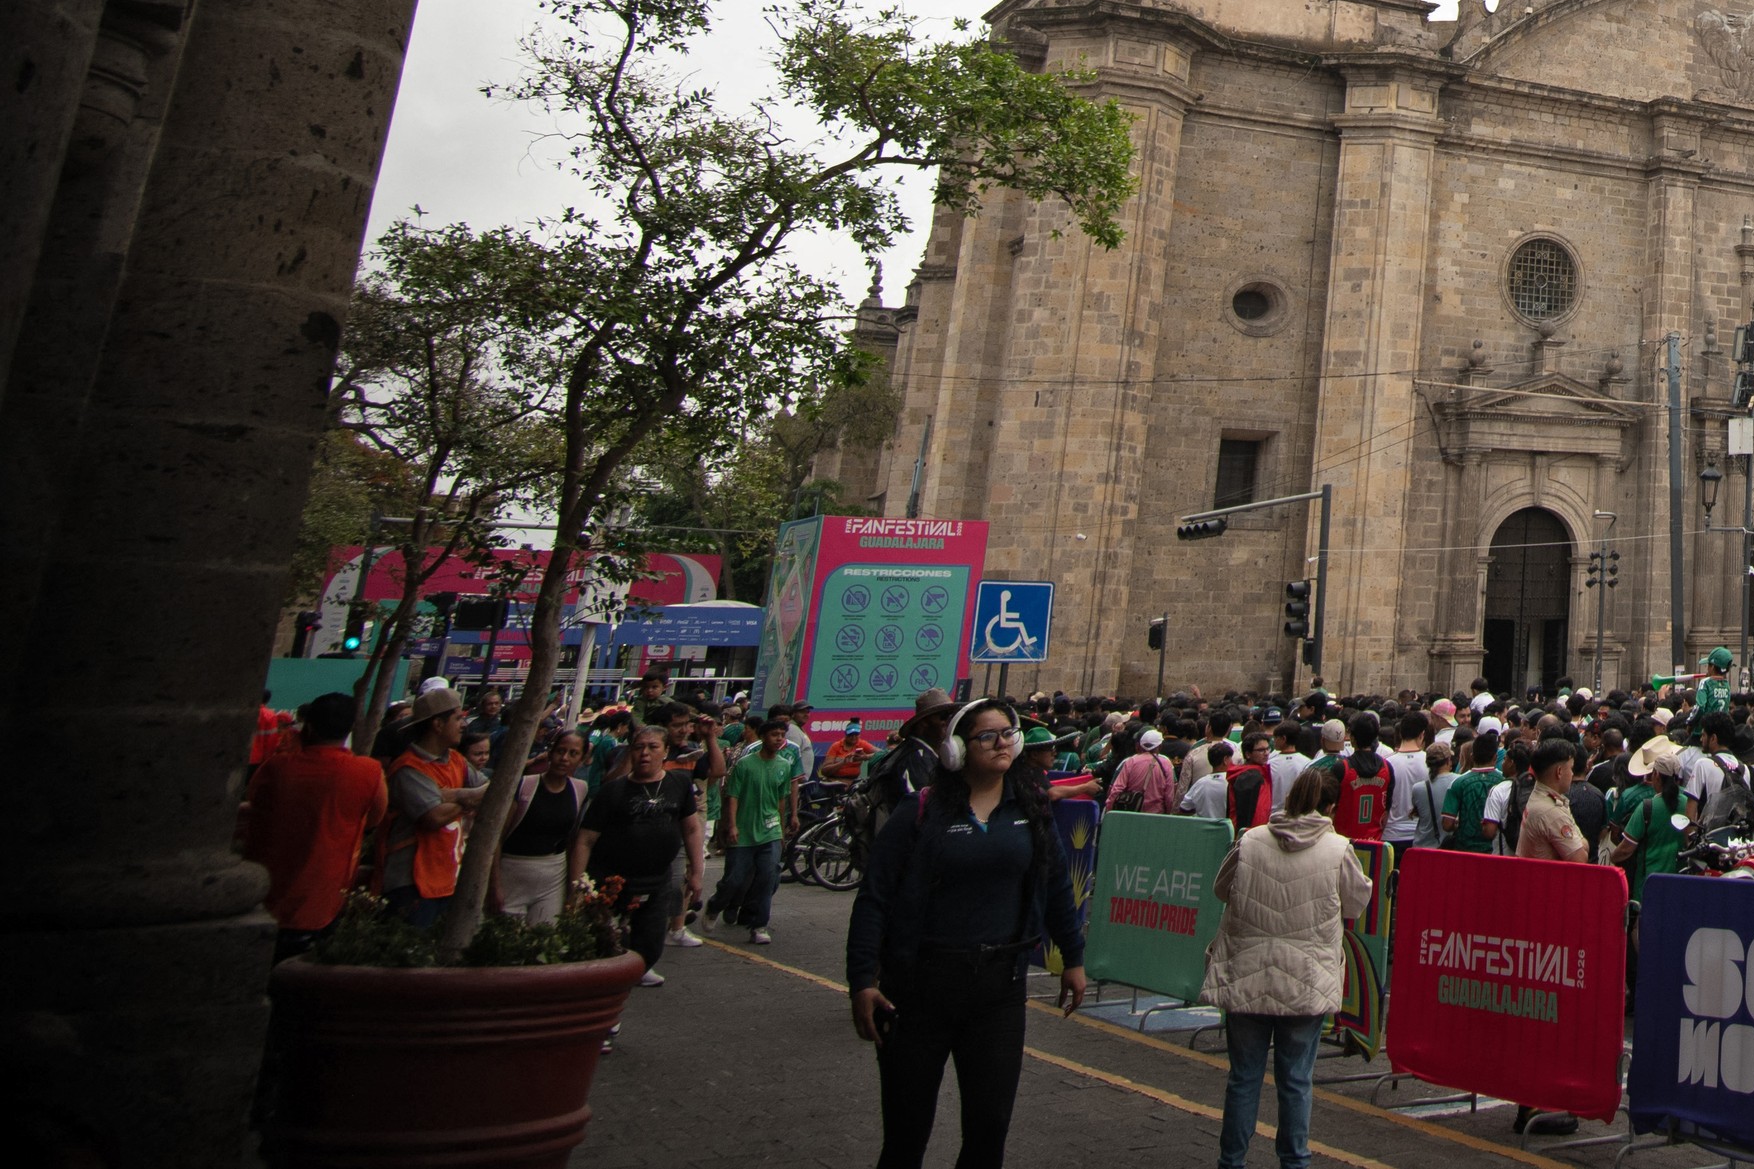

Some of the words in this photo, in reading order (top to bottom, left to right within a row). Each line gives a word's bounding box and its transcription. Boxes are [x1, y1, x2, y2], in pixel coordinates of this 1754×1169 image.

[859, 536, 945, 549] GUADALAJARA
[843, 568, 952, 578] RESTRICCIONES
[811, 720, 862, 732] SOM
[1115, 864, 1151, 894] WE
[1151, 869, 1203, 901] ARE
[1110, 895, 1160, 930] TAPATÍO
[1159, 903, 1198, 936] PRIDE
[1419, 929, 1429, 964] FIFA
[1576, 949, 1586, 989] 2026
[1438, 974, 1558, 1023] GUADALAJARA
